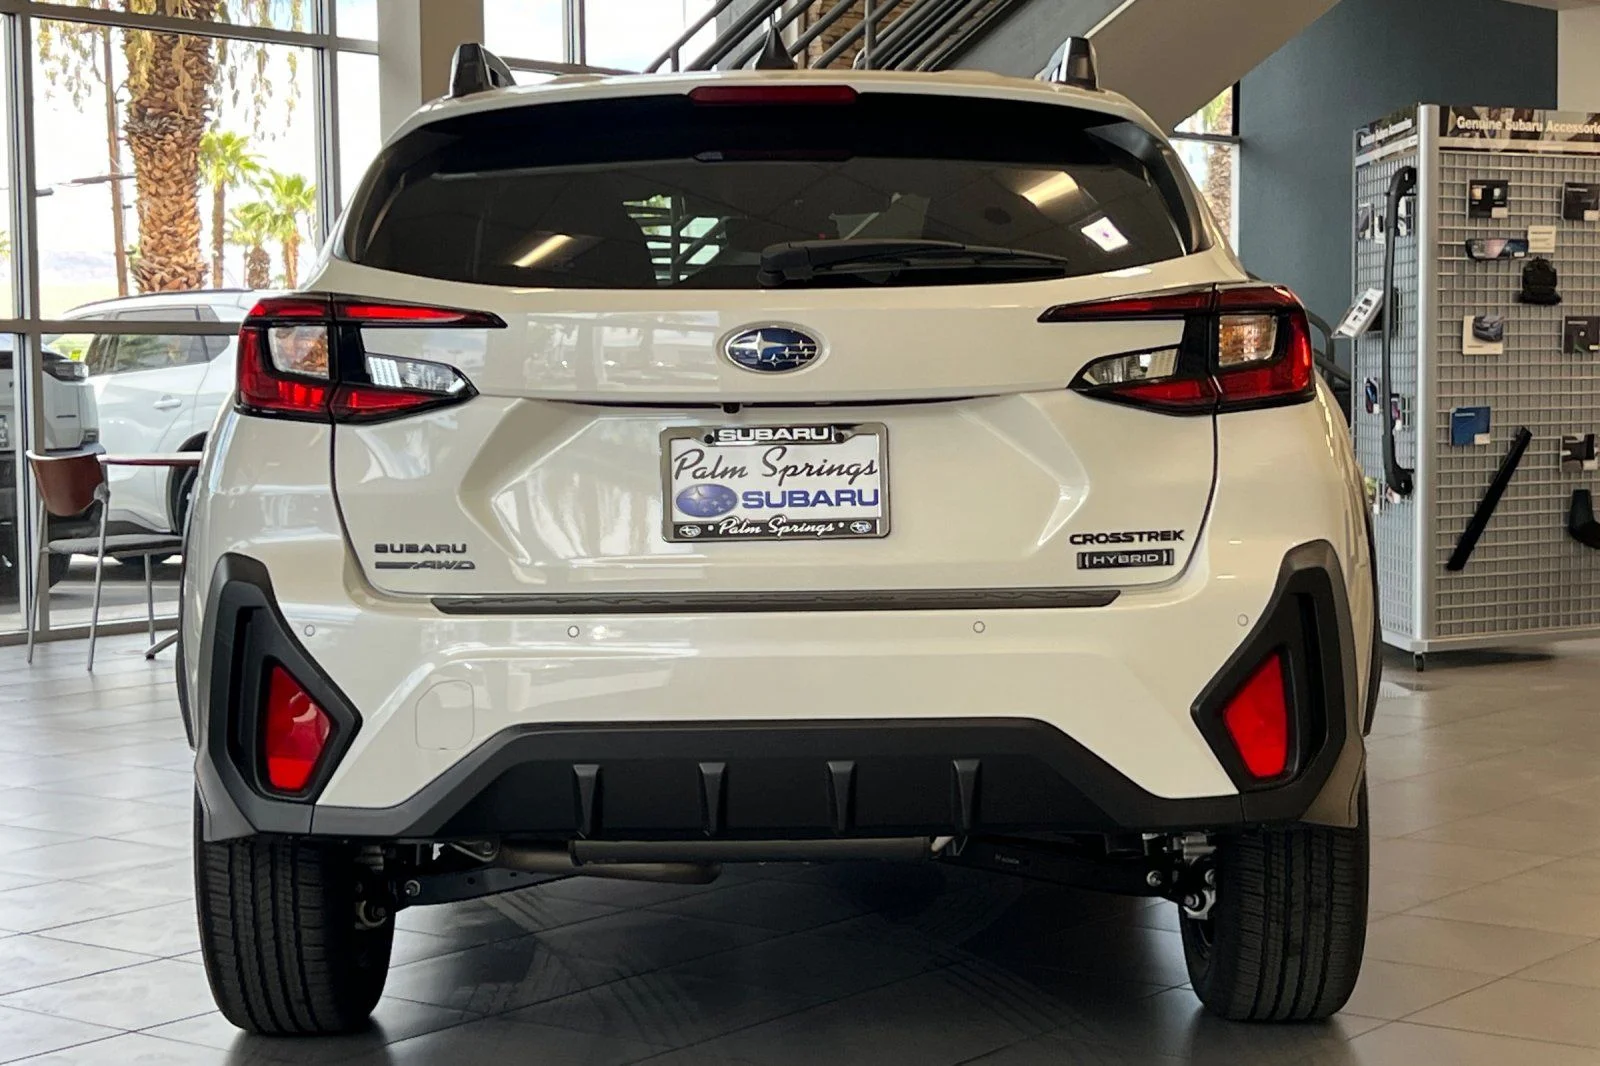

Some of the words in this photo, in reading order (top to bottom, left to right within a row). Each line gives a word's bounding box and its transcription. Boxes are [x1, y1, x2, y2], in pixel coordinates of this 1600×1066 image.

[1457, 116, 1503, 130] Genuine
[1505, 118, 1543, 132] Subaru
[718, 427, 829, 441] SUBARU
[674, 448, 748, 480] Palm
[762, 446, 878, 486] Springs
[742, 489, 879, 509] SUBARU
[719, 515, 761, 535] Palm
[768, 514, 835, 536] Springs
[1069, 530, 1185, 545] CROSSTREK
[374, 543, 467, 553] SUBARU
[413, 560, 476, 569] AWD
[1092, 553, 1159, 565] HYBRID
